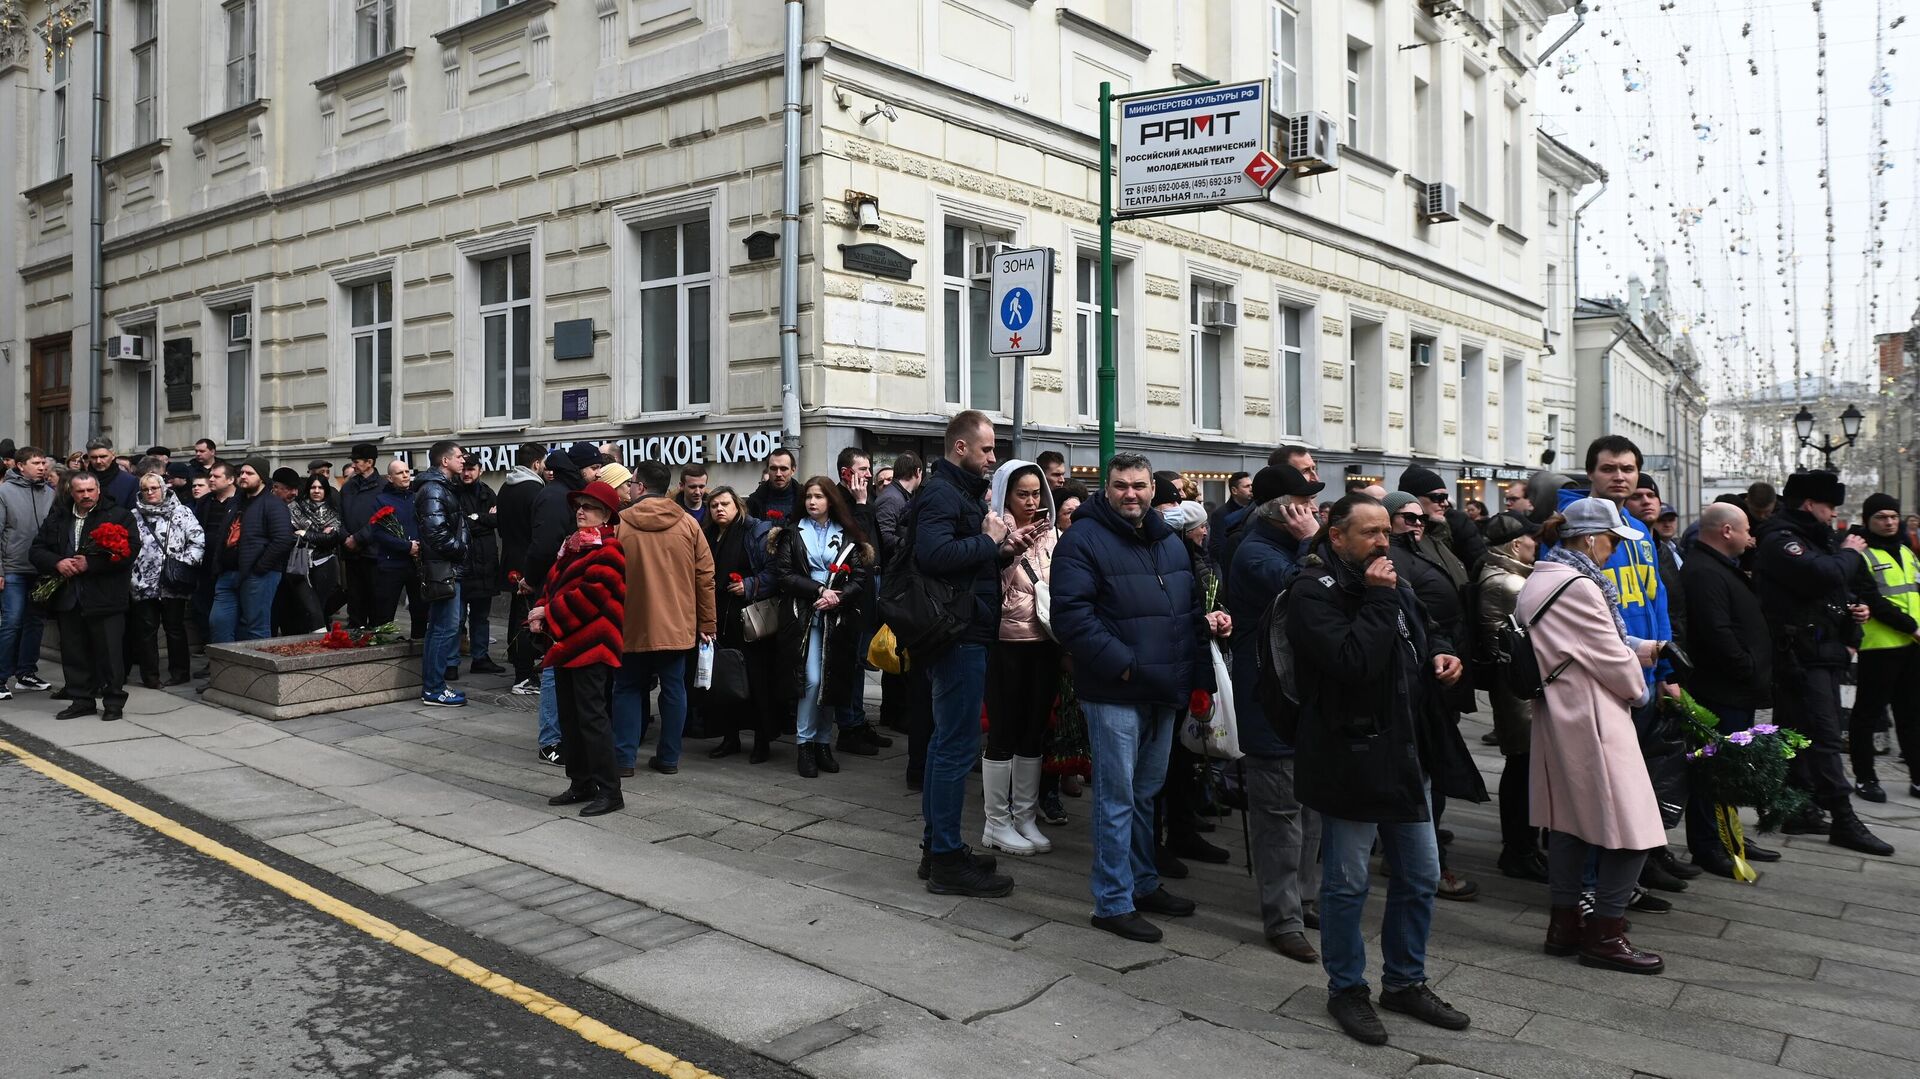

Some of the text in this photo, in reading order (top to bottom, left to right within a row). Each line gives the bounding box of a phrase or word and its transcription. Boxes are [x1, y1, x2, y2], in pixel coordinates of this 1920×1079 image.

[1129, 89, 1255, 115] МИНИСТЕРСТВО КУЛЬТУРЫ РФ
[1140, 111, 1240, 145] РАМТ
[1125, 138, 1257, 163] РОССИЙСКИЙ АКАДЕМИЧЕСКИЙ
[1146, 156, 1235, 173] МОЛОДЕЖНЫЙ ТЕАТР
[1136, 174, 1242, 195] 8 (495) 692-00-69, (495) 692-18-79
[1125, 187, 1226, 206] ТЕАТРАЛЬНАЯ пл., д.2
[1002, 257, 1035, 274] ЗОНА
[715, 430, 782, 464] КАФЕ
